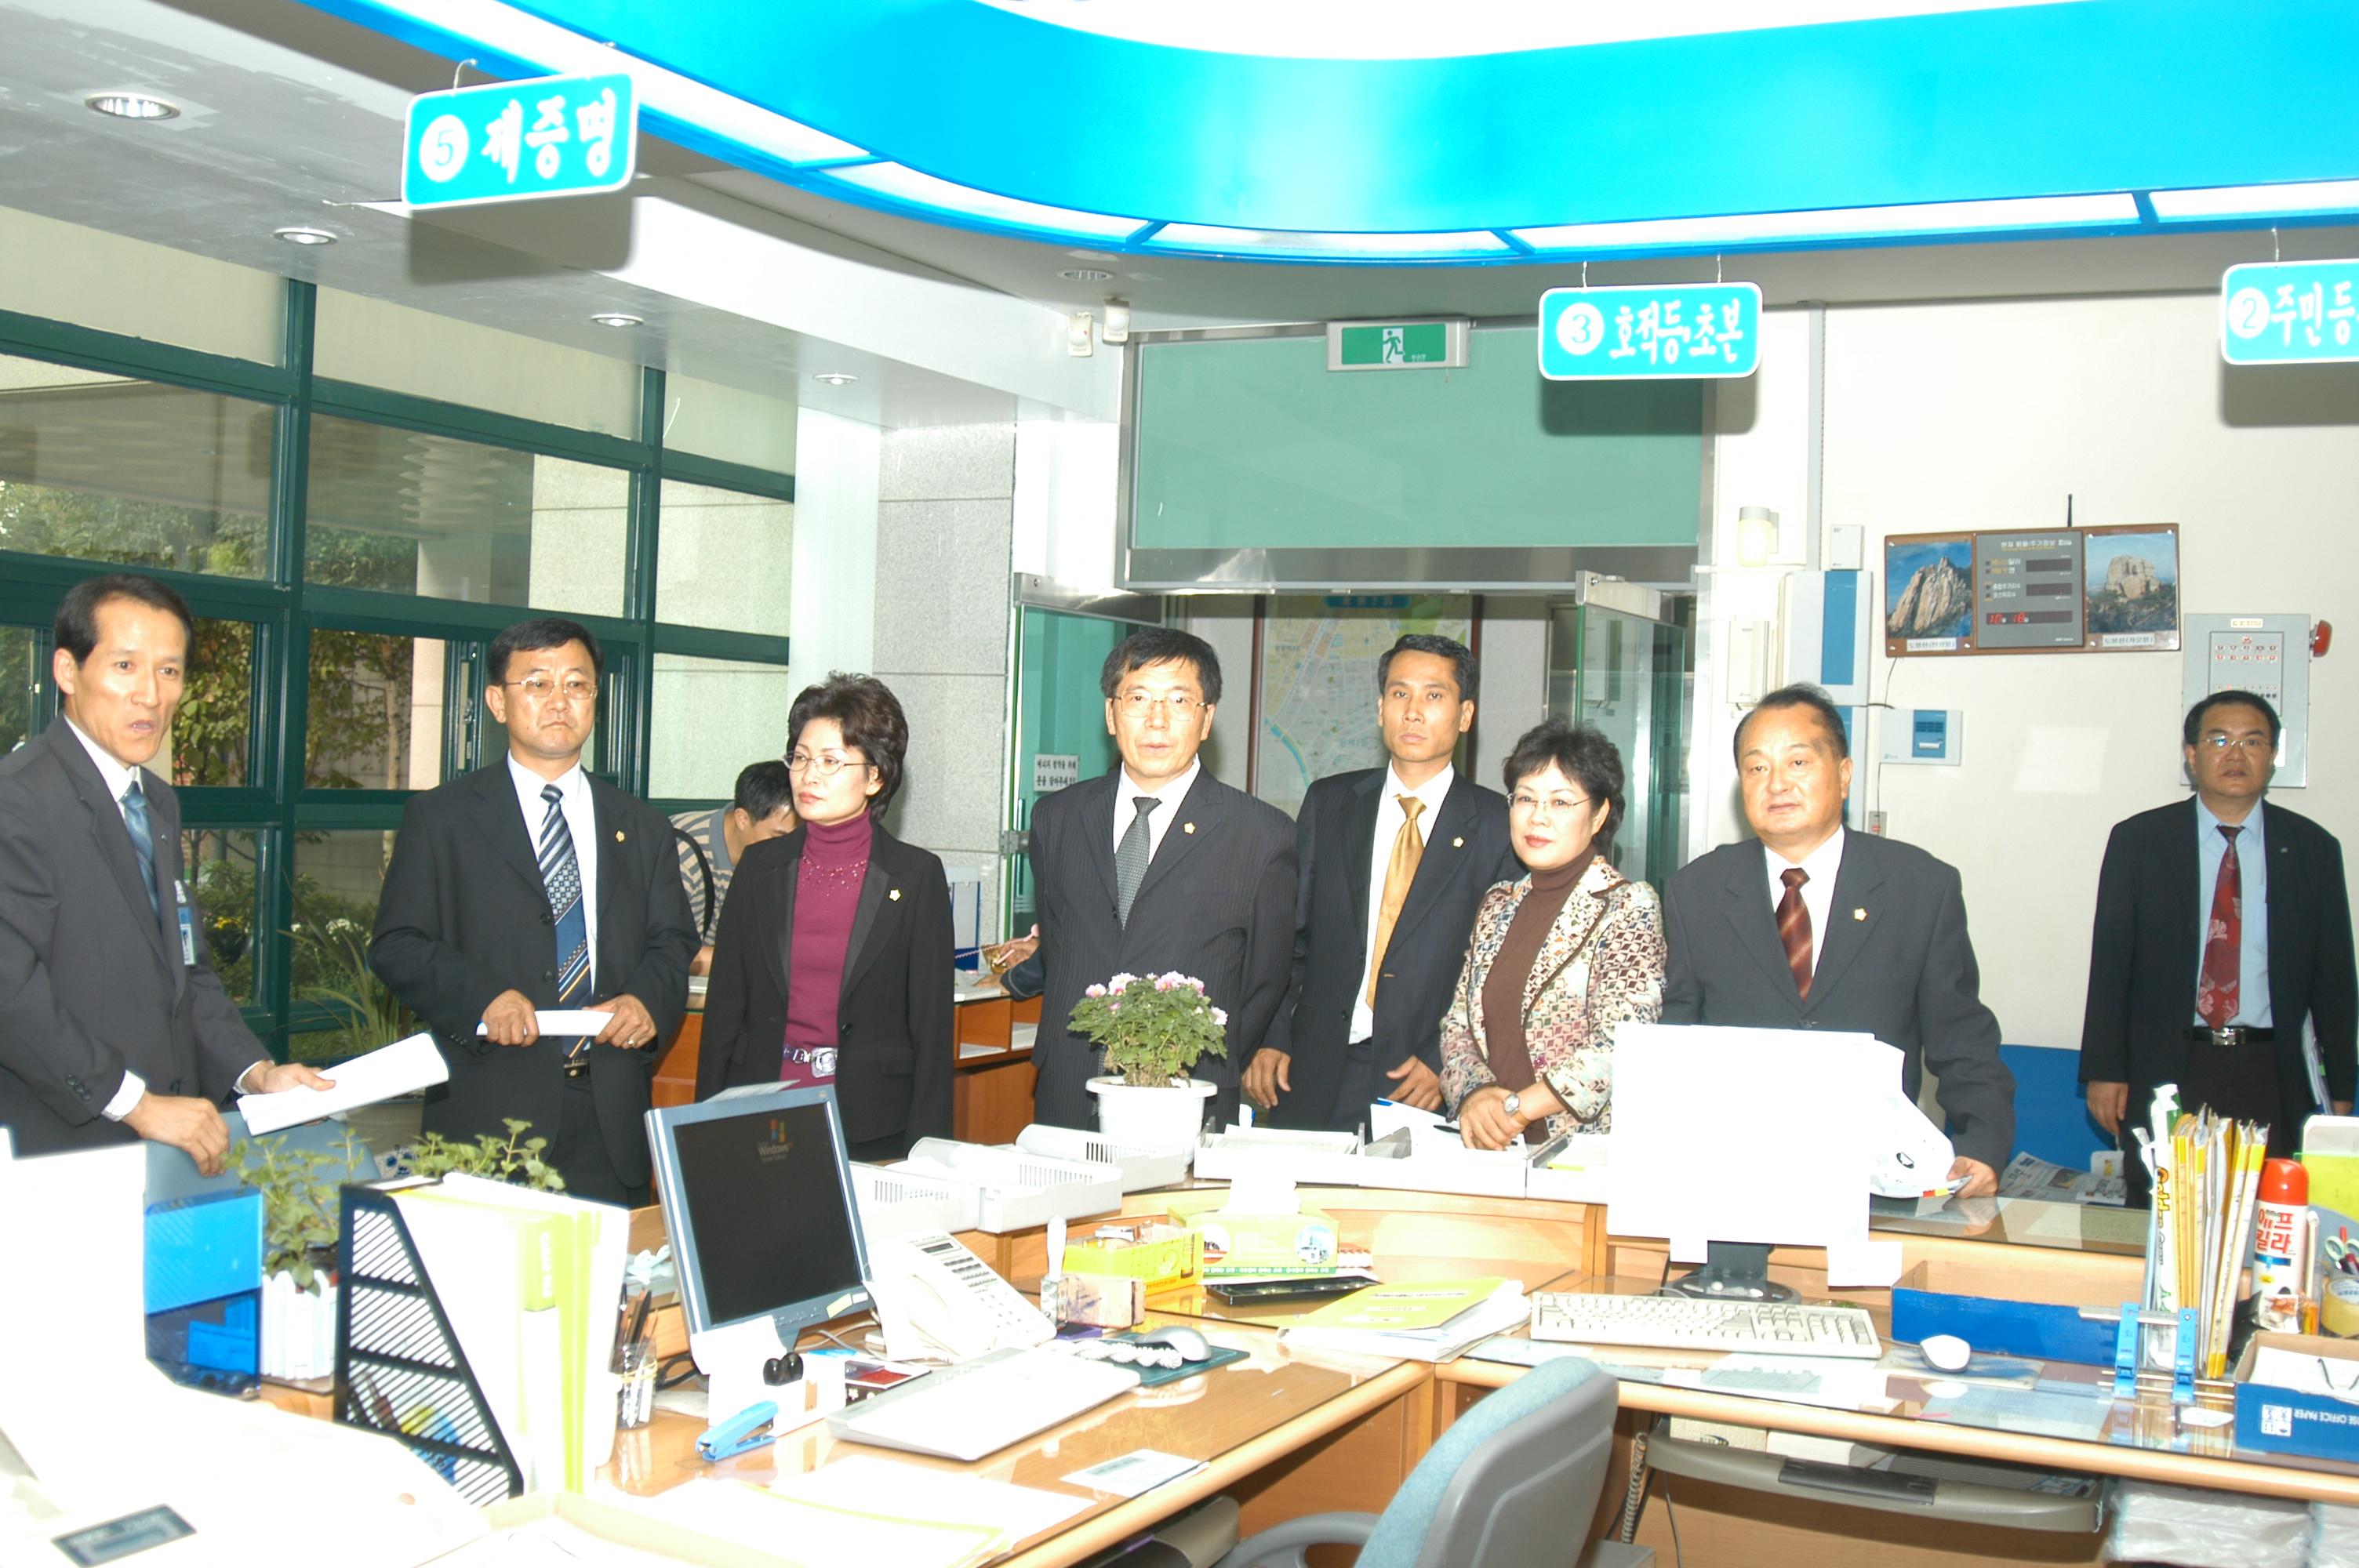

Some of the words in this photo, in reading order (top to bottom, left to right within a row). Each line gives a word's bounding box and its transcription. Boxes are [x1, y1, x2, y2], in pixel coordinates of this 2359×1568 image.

[481, 87, 616, 184] 제증명
[2270, 280, 2359, 347] 주민등
[2294, 1408, 2318, 1421] PAPER
[2319, 1411, 2347, 1425] OFFICE
